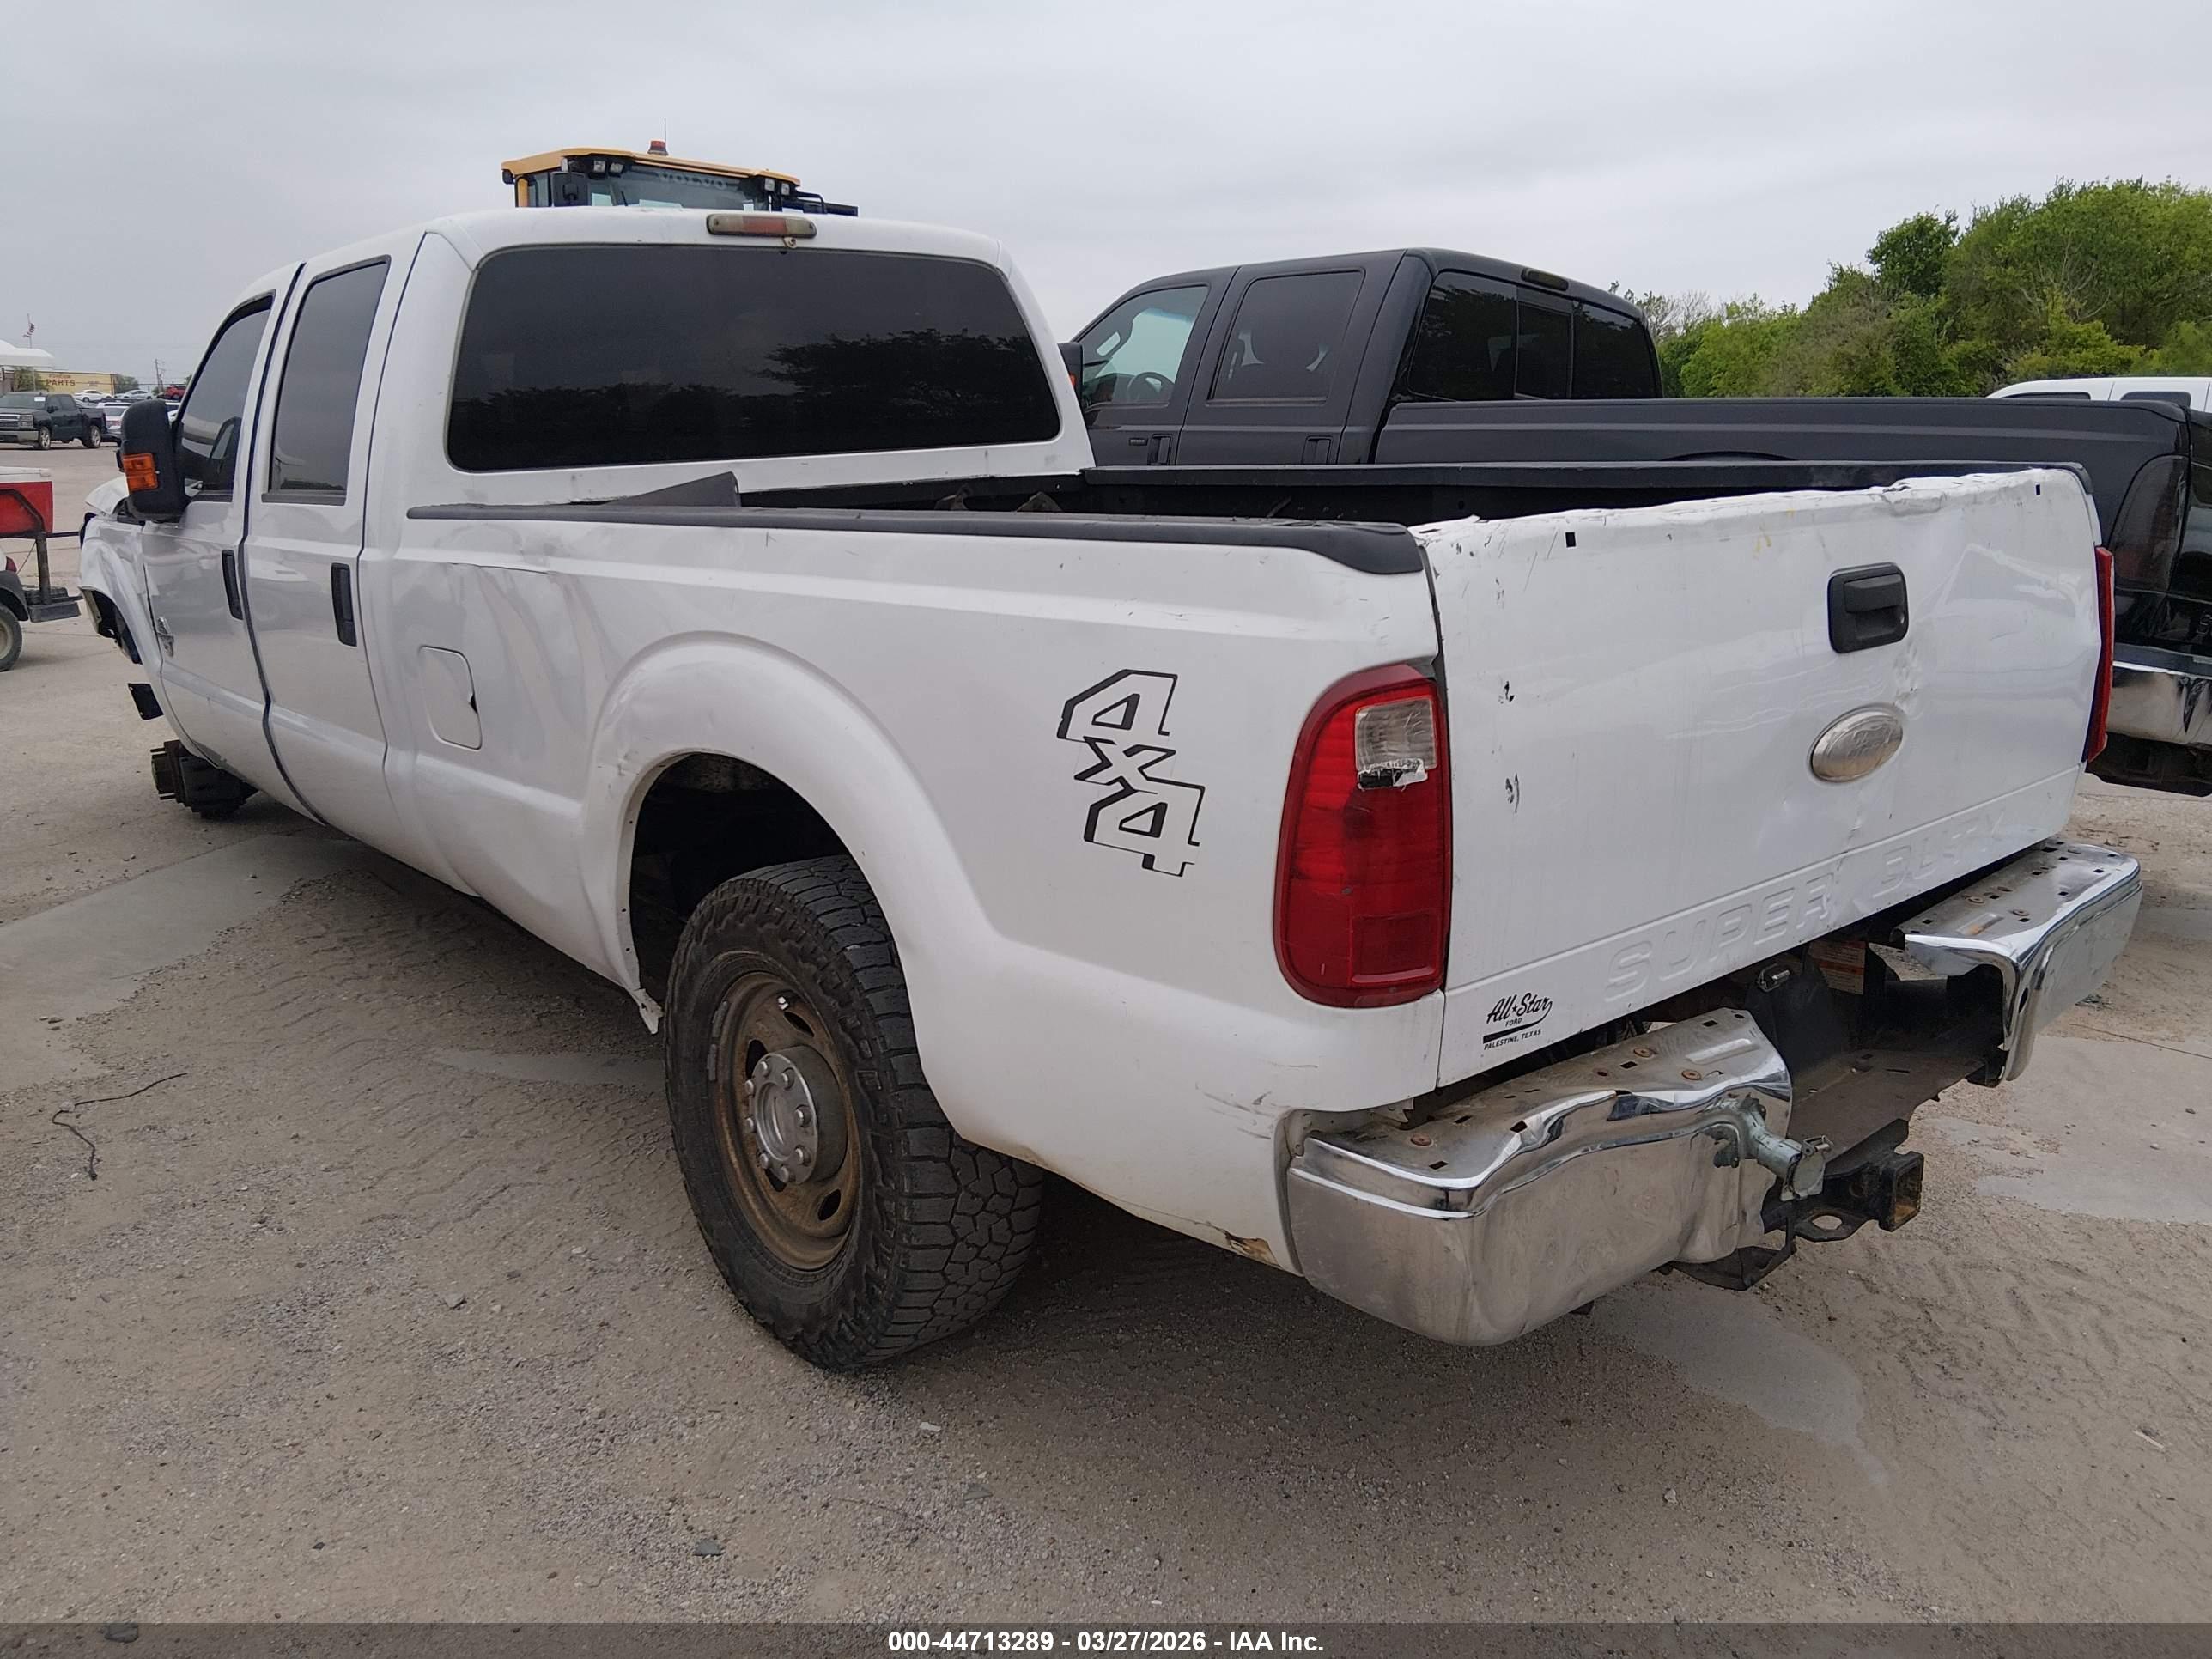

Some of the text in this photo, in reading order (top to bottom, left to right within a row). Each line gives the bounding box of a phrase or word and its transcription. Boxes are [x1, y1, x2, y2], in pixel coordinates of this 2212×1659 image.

[1604, 872, 1834, 1002] SUPER
[1504, 1017, 1522, 1027] FORD
[1521, 1029, 1541, 1041] TEXAS
